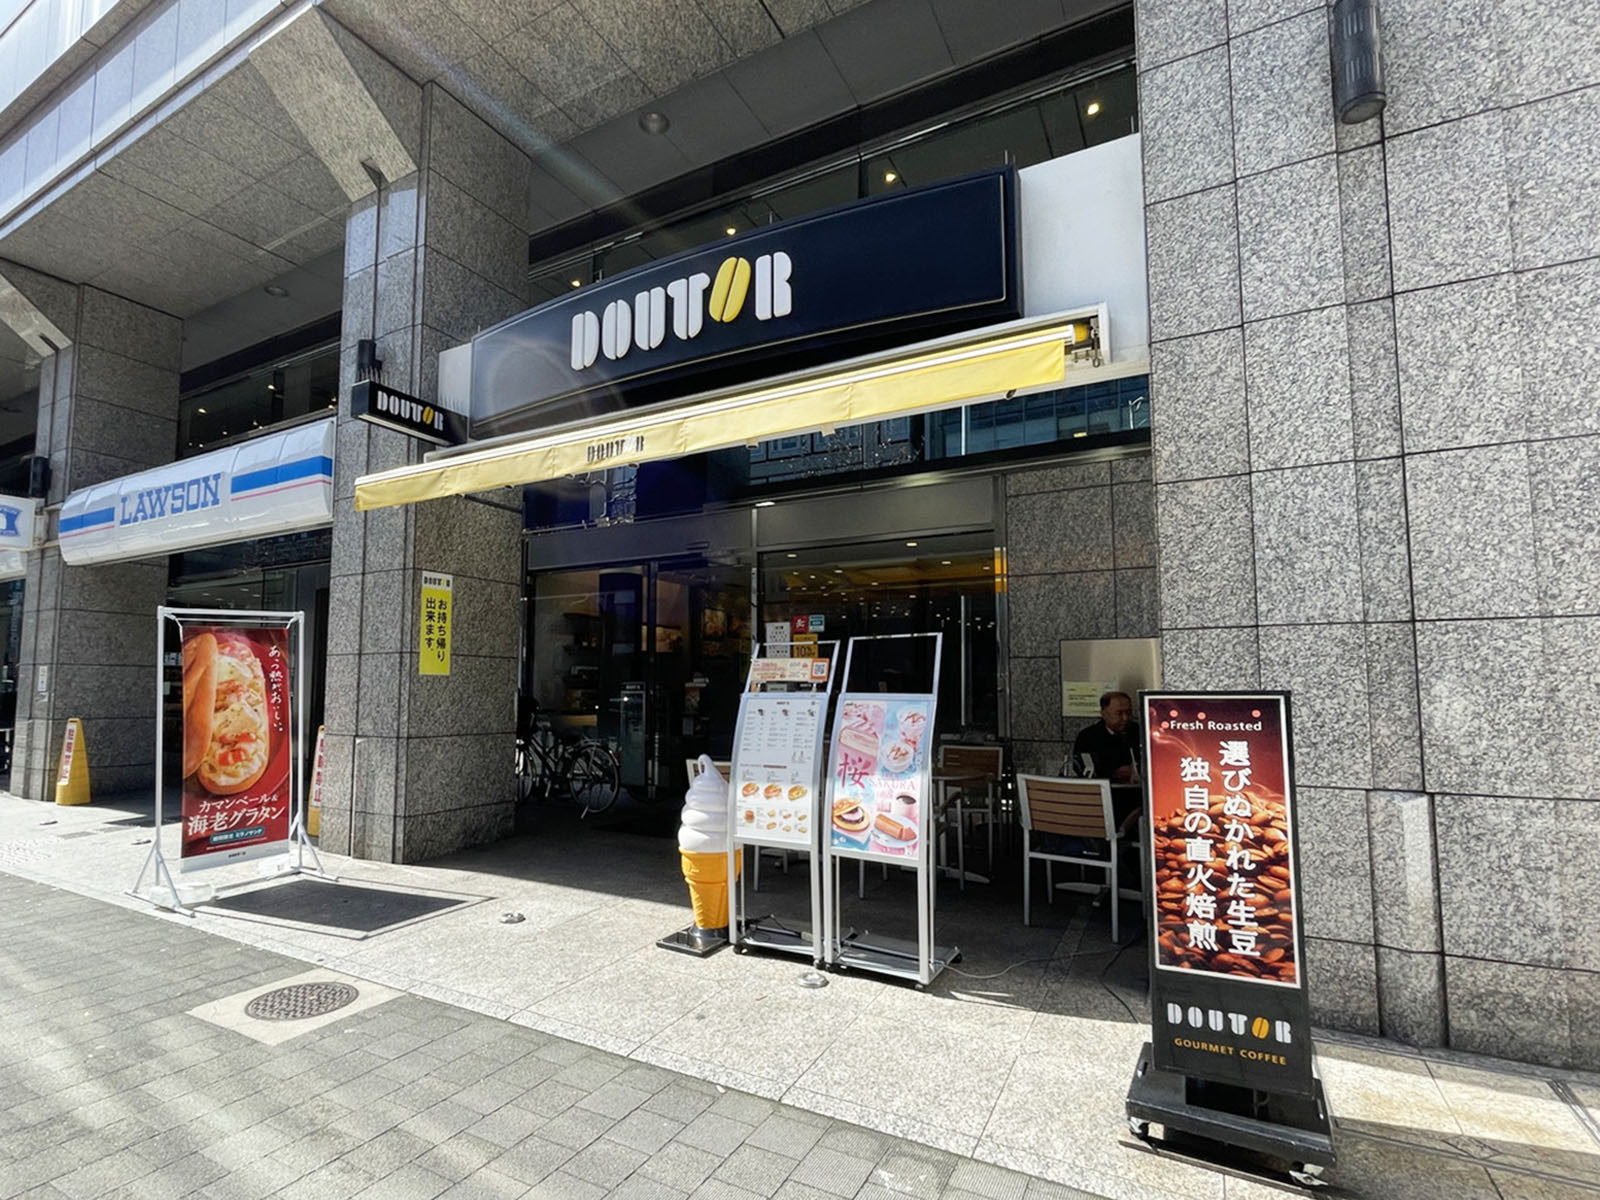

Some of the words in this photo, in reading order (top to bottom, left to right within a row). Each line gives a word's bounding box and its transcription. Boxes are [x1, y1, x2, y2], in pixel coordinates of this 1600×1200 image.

[571, 251, 793, 371] DOUTOR
[377, 390, 444, 431] DOUTOR
[587, 435, 645, 462] DOUTOR
[120, 473, 222, 525] LAWSON
[436, 599, 448, 662] お持ち帰り
[1170, 720, 1204, 730] Fresh
[1207, 721, 1262, 731] Roasted
[837, 752, 872, 789] 桜
[188, 806, 286, 836] 海老グラタン
[1180, 757, 1218, 951] 独自の直火焙煎
[1219, 741, 1260, 957] 選びぬかれた生豆
[1167, 1002, 1292, 1044] DOUTOR
[1174, 1037, 1234, 1055] GOURMET
[1239, 1049, 1287, 1066] COFFEE
